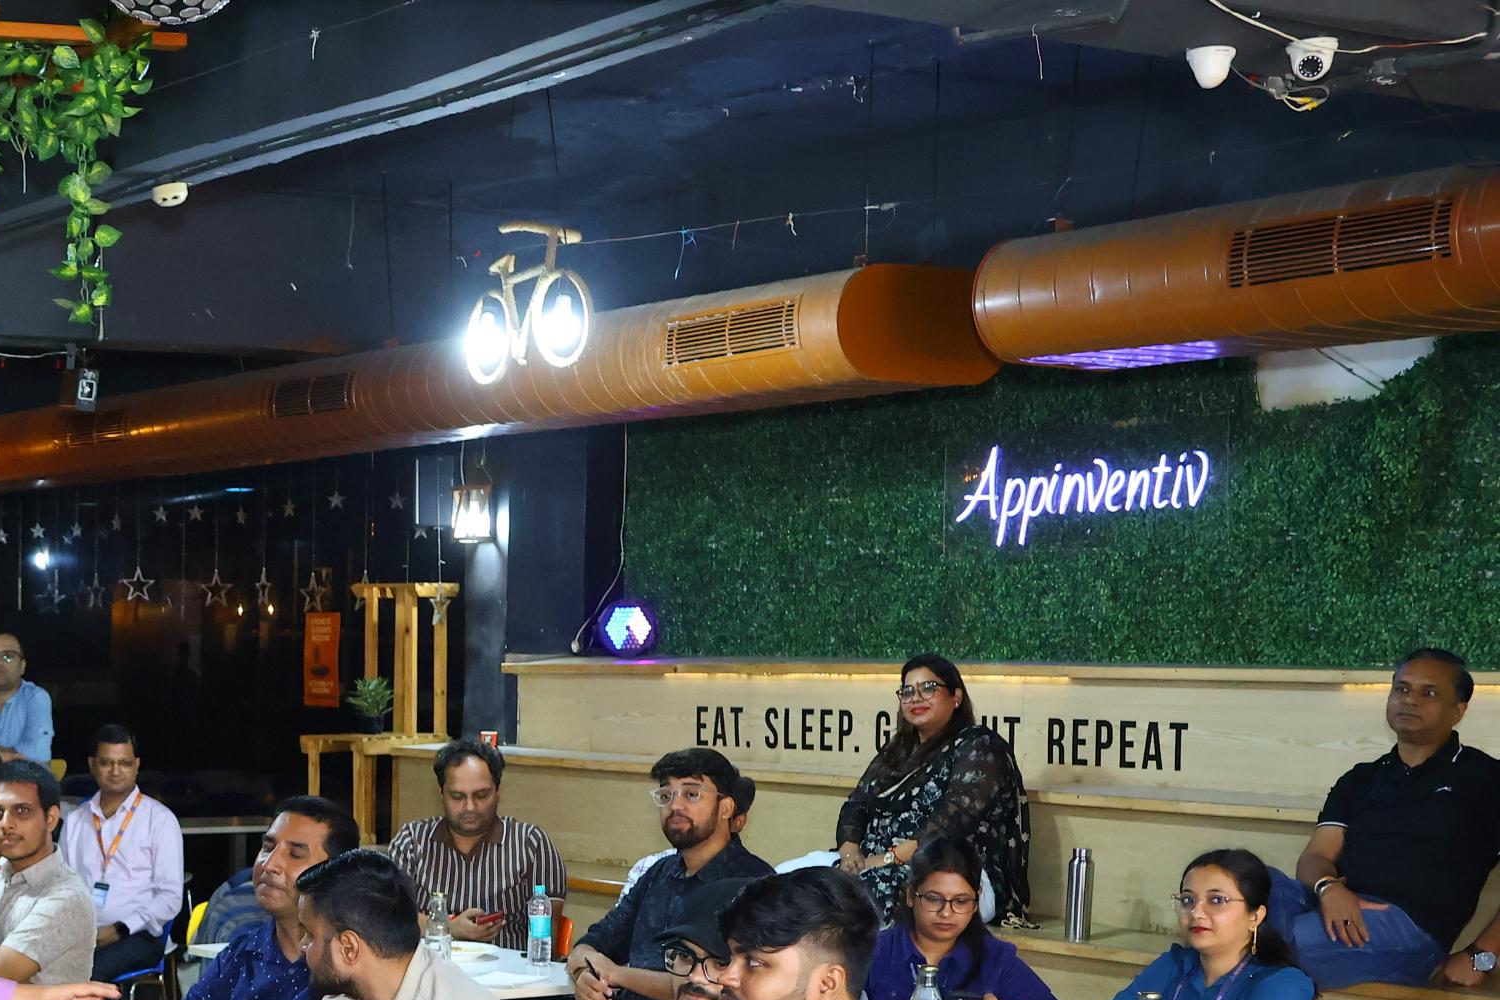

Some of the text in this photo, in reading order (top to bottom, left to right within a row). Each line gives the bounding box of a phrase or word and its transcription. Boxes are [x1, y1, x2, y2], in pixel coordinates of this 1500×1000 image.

[956, 445, 1209, 547] Appinventiv
[696, 706, 750, 748] EAT.
[765, 707, 859, 752] SLEEP.
[1047, 718, 1189, 771] REPEAT
